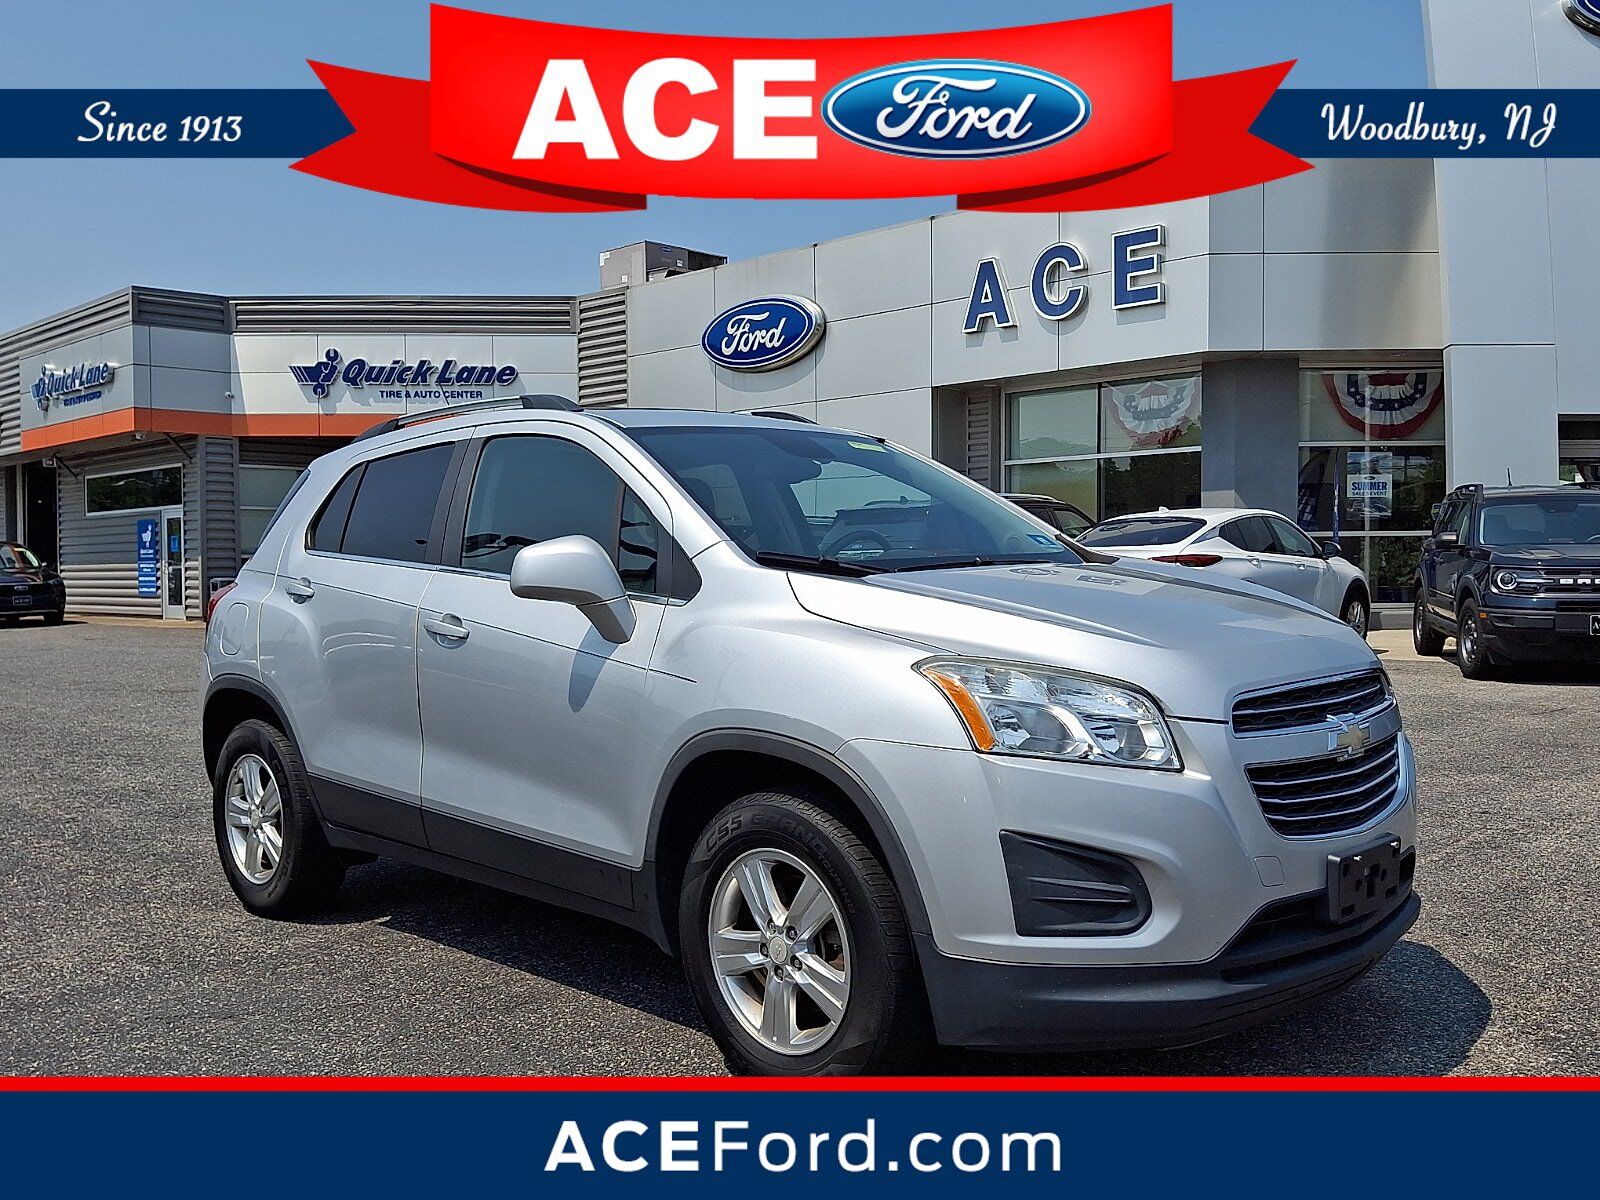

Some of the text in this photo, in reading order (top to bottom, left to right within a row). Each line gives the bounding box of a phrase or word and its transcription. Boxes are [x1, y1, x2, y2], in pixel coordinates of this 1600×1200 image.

[962, 224, 1165, 334] ACE
[721, 311, 786, 356] Ford
[47, 362, 109, 397] Quick Lane
[342, 358, 518, 388] Quick Lane
[379, 390, 483, 398] TIRE & AUTO CENTER
[1352, 482, 1388, 491] SUMMER
